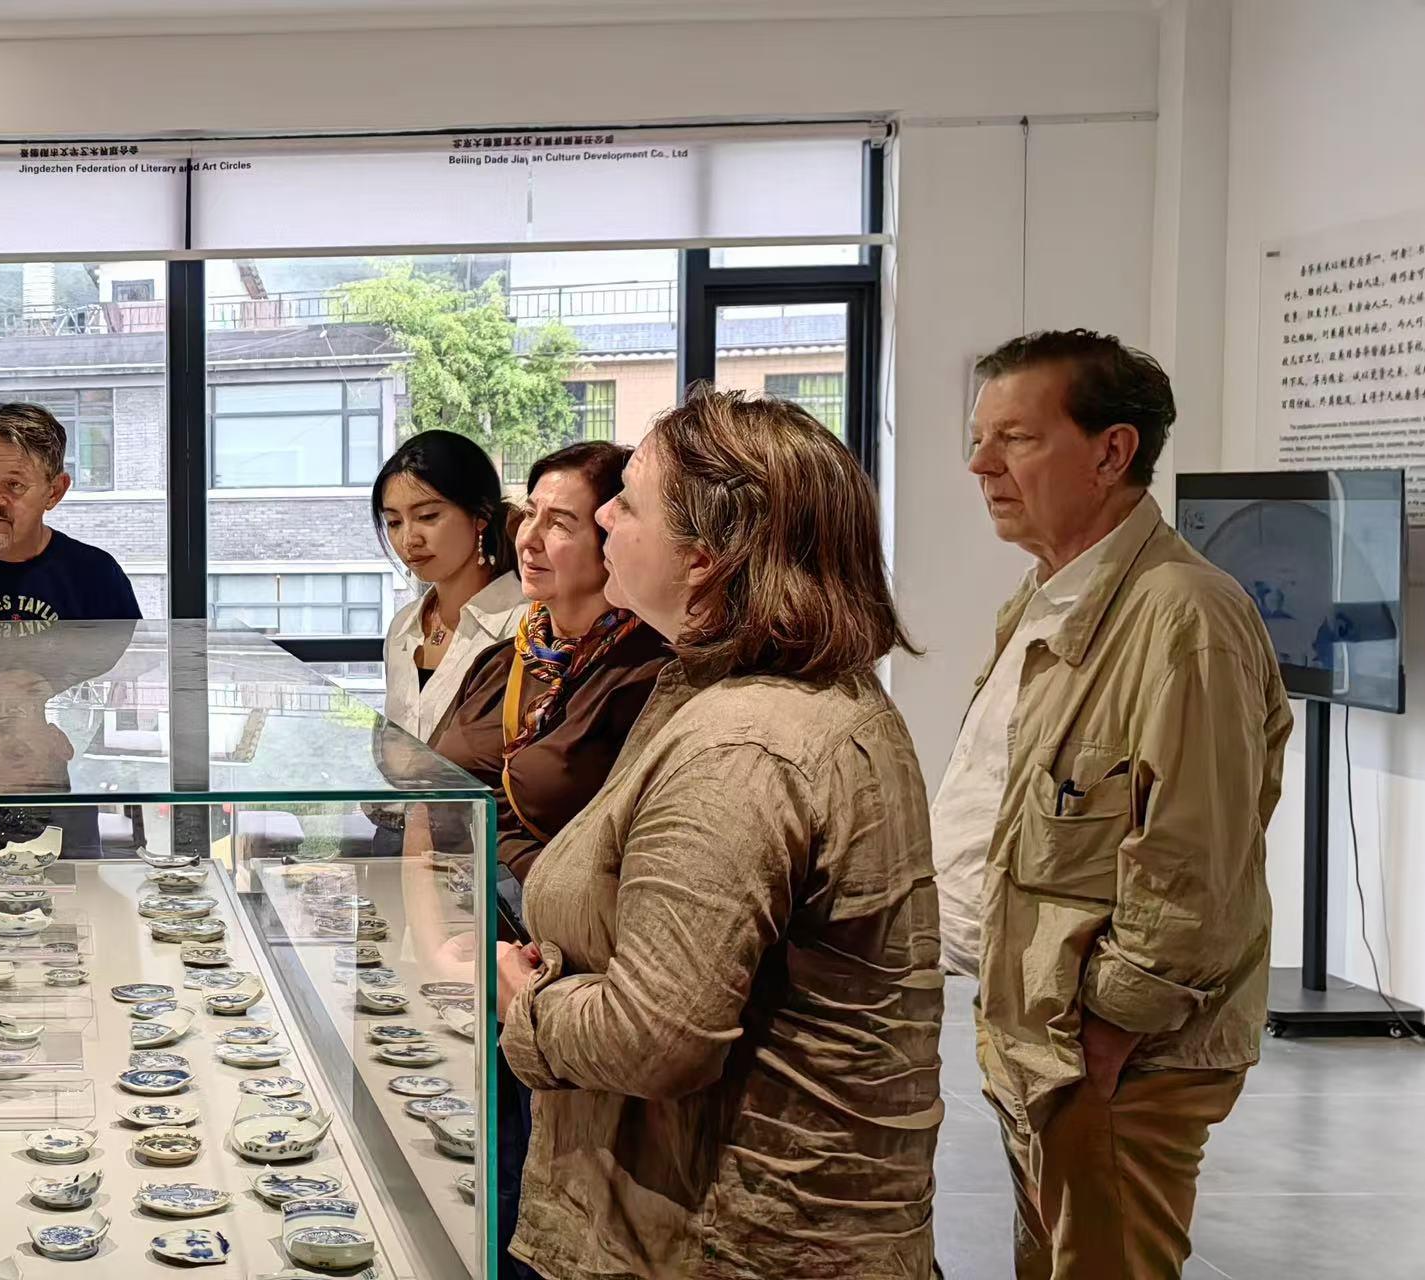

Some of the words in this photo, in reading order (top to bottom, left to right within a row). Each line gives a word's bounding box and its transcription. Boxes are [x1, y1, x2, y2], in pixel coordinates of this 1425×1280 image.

[484, 154, 509, 165] Dade
[545, 152, 581, 162] Culture
[583, 150, 648, 161] Development
[19, 164, 73, 175] Jingdezhen
[76, 163, 126, 173] Federation
[128, 163, 139, 173] of
[141, 163, 177, 174] Literary
[202, 162, 217, 171] Art
[220, 161, 252, 171] Circles
